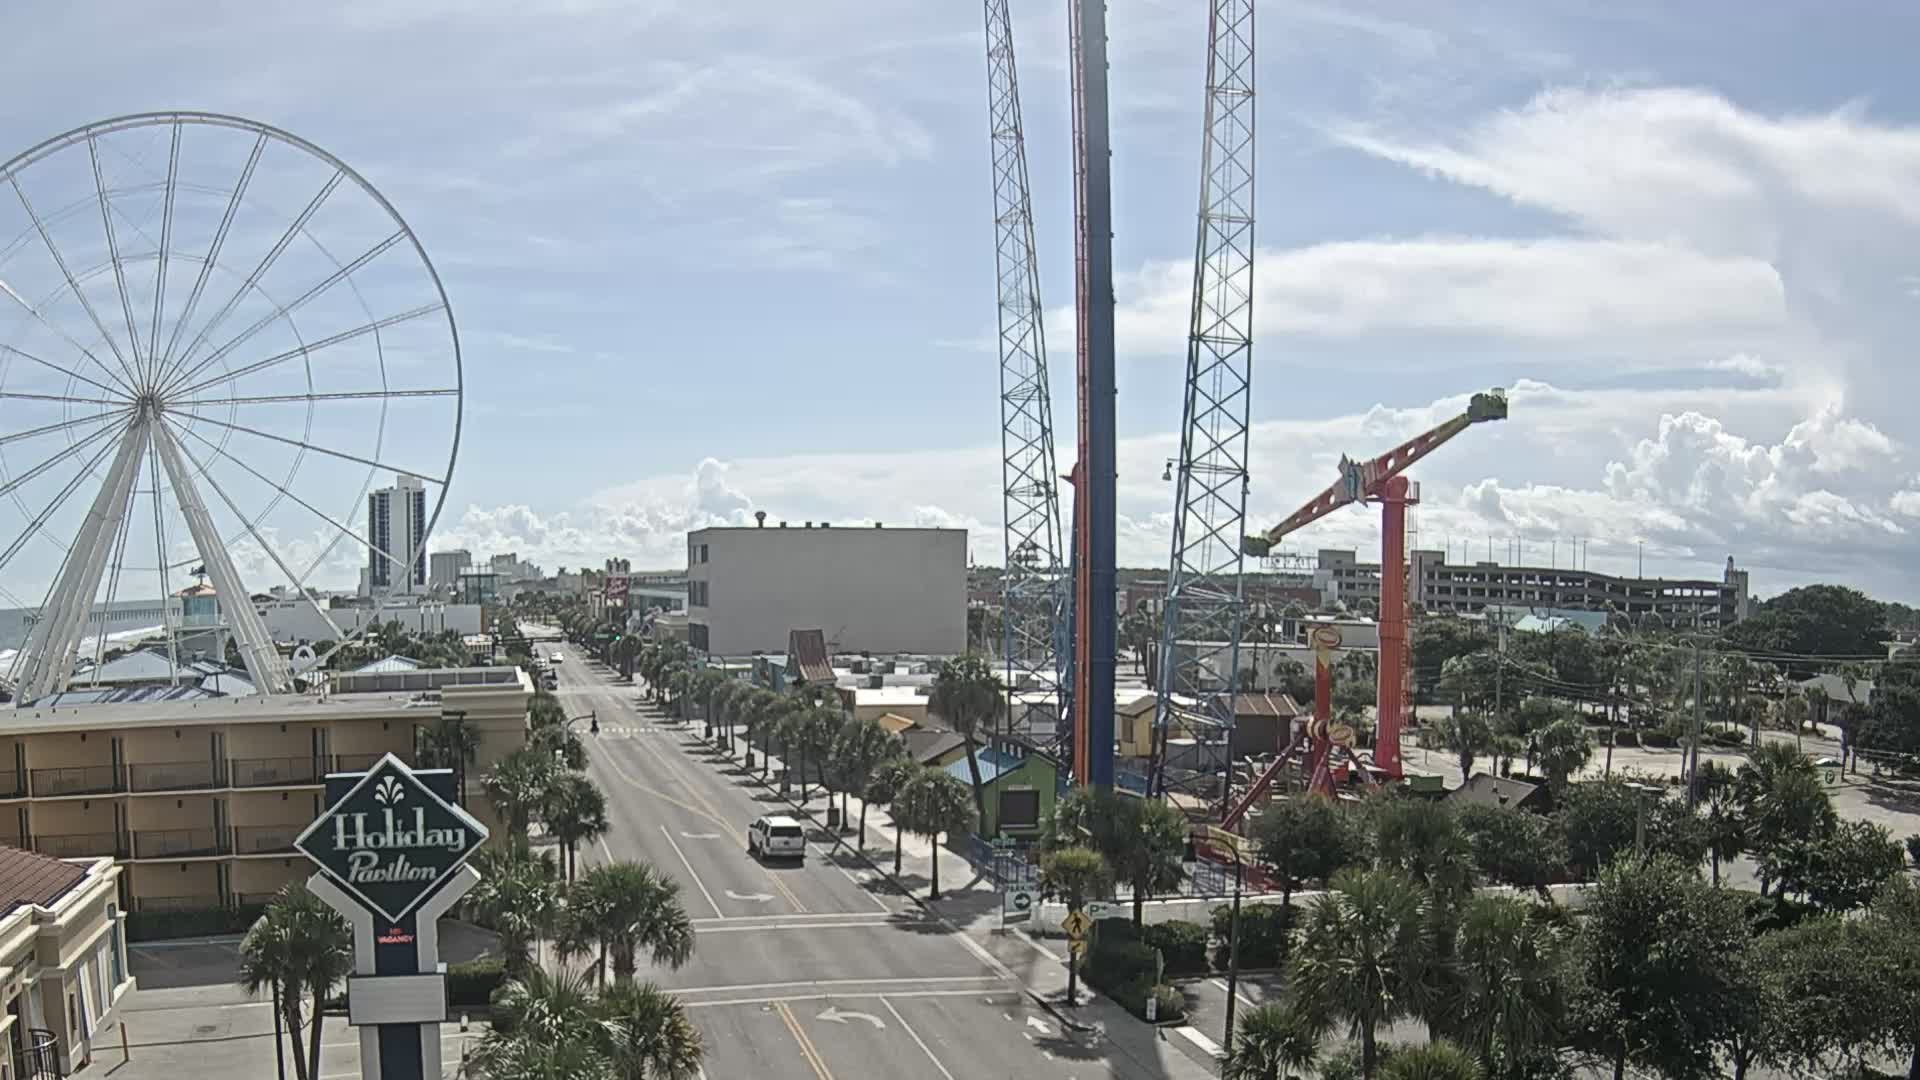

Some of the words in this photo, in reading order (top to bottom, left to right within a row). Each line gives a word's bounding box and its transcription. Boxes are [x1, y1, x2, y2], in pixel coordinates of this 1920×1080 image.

[333, 807, 465, 851] Holiday
[348, 851, 436, 882] Pavilion
[1090, 905, 1100, 917] P
[377, 935, 414, 944] VACANCY
